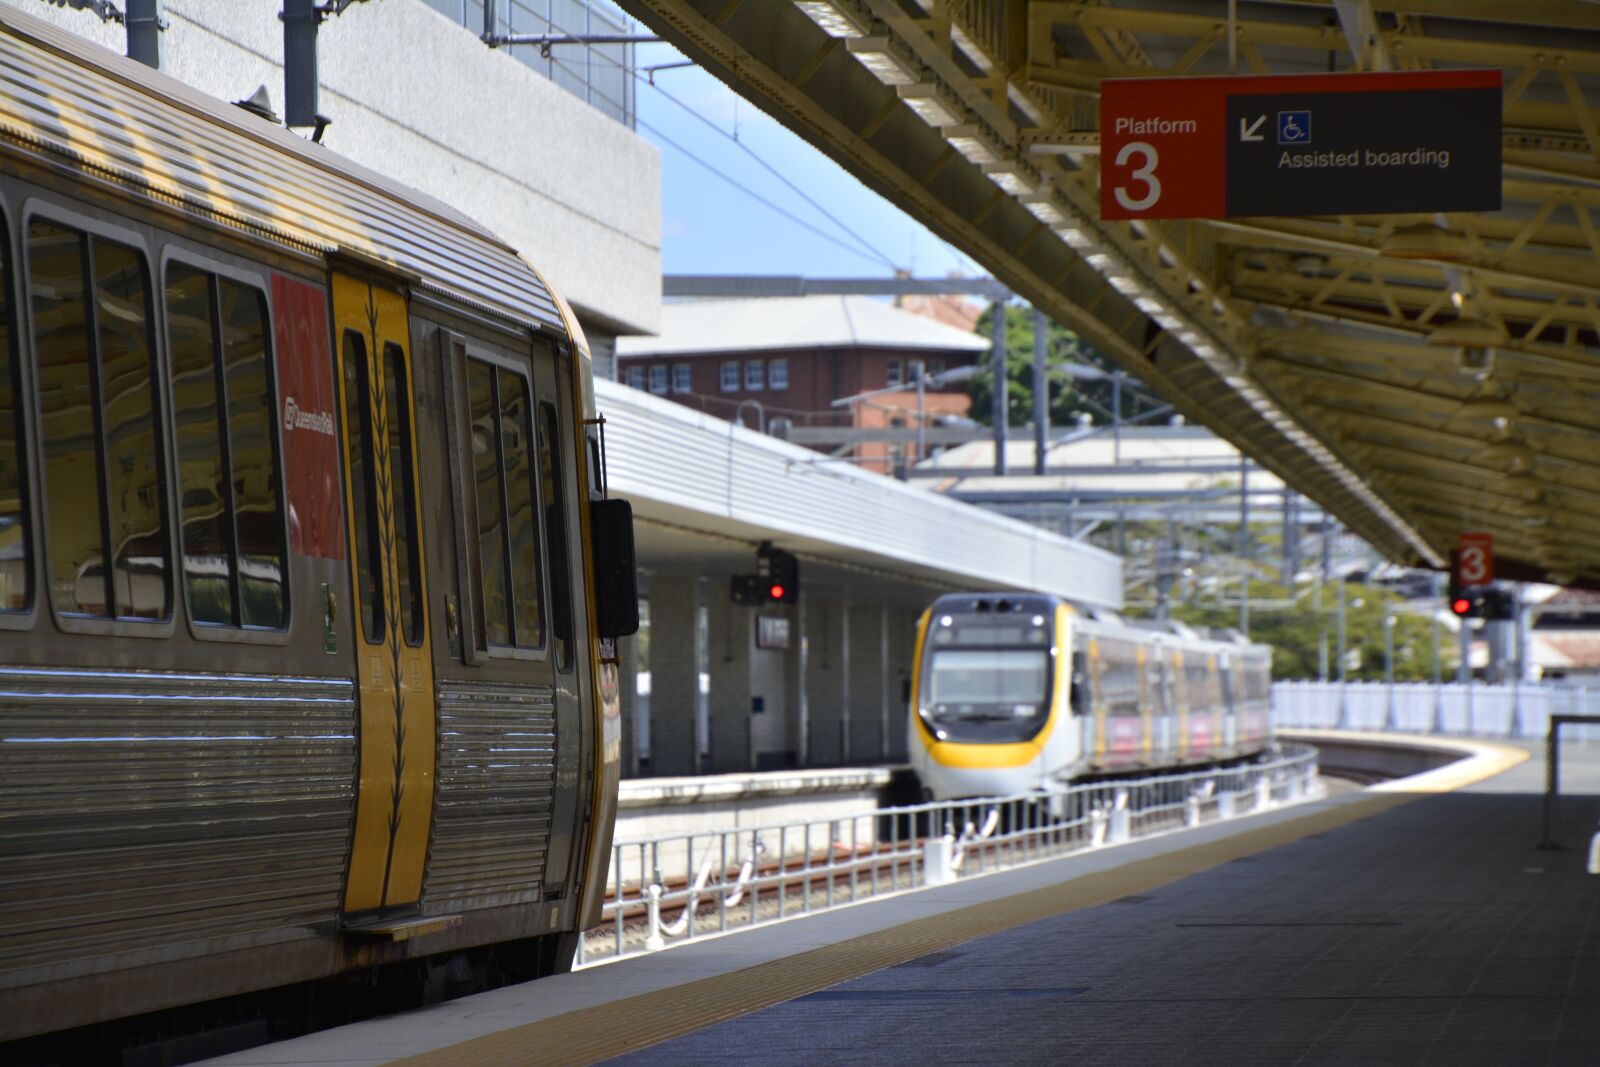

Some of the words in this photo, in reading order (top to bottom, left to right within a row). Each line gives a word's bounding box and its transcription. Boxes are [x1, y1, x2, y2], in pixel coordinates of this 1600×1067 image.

[1115, 118, 1197, 135] Platform
[1278, 150, 1360, 169] Assisted
[1365, 148, 1451, 168] boarding
[1115, 142, 1161, 212] 3
[1461, 547, 1486, 579] 3
